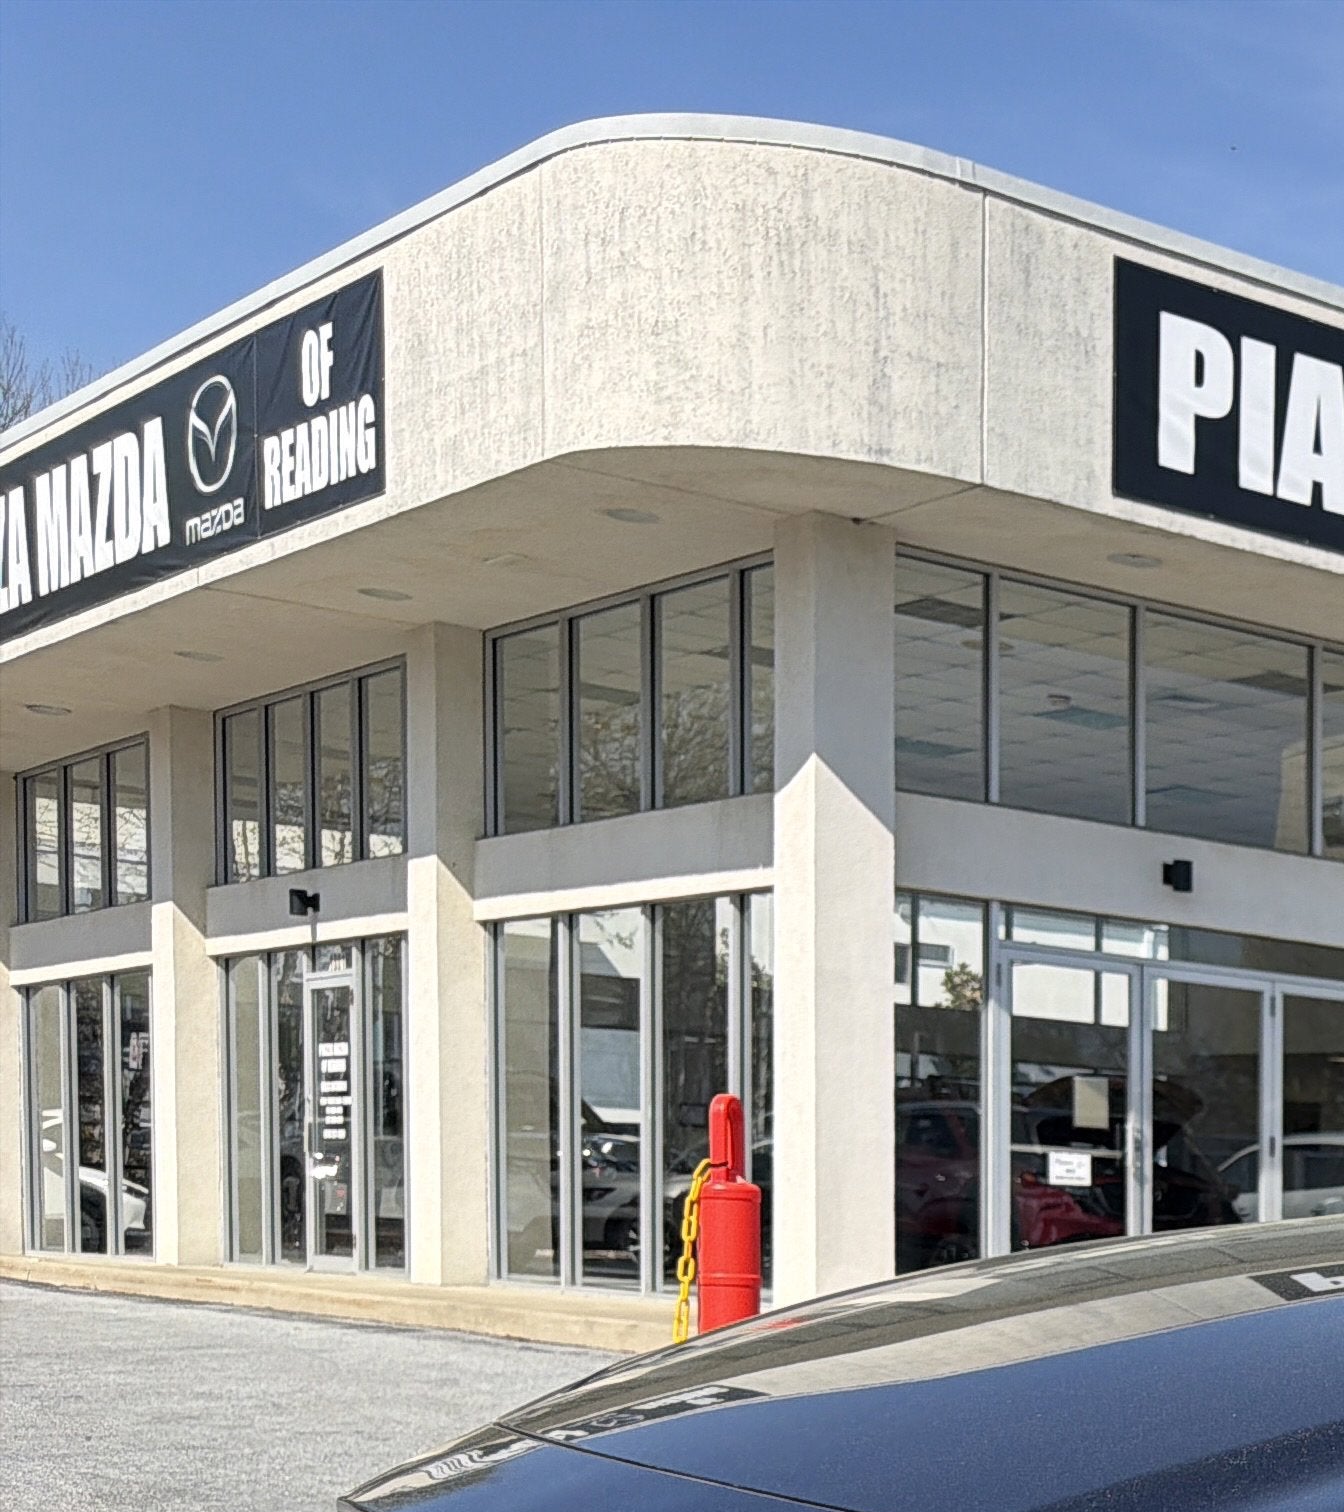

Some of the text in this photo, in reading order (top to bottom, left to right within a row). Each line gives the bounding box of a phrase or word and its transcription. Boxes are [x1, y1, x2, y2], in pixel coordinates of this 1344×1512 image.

[301, 321, 336, 407] OF
[35, 416, 171, 598] MAZDA
[263, 394, 376, 511] READING
